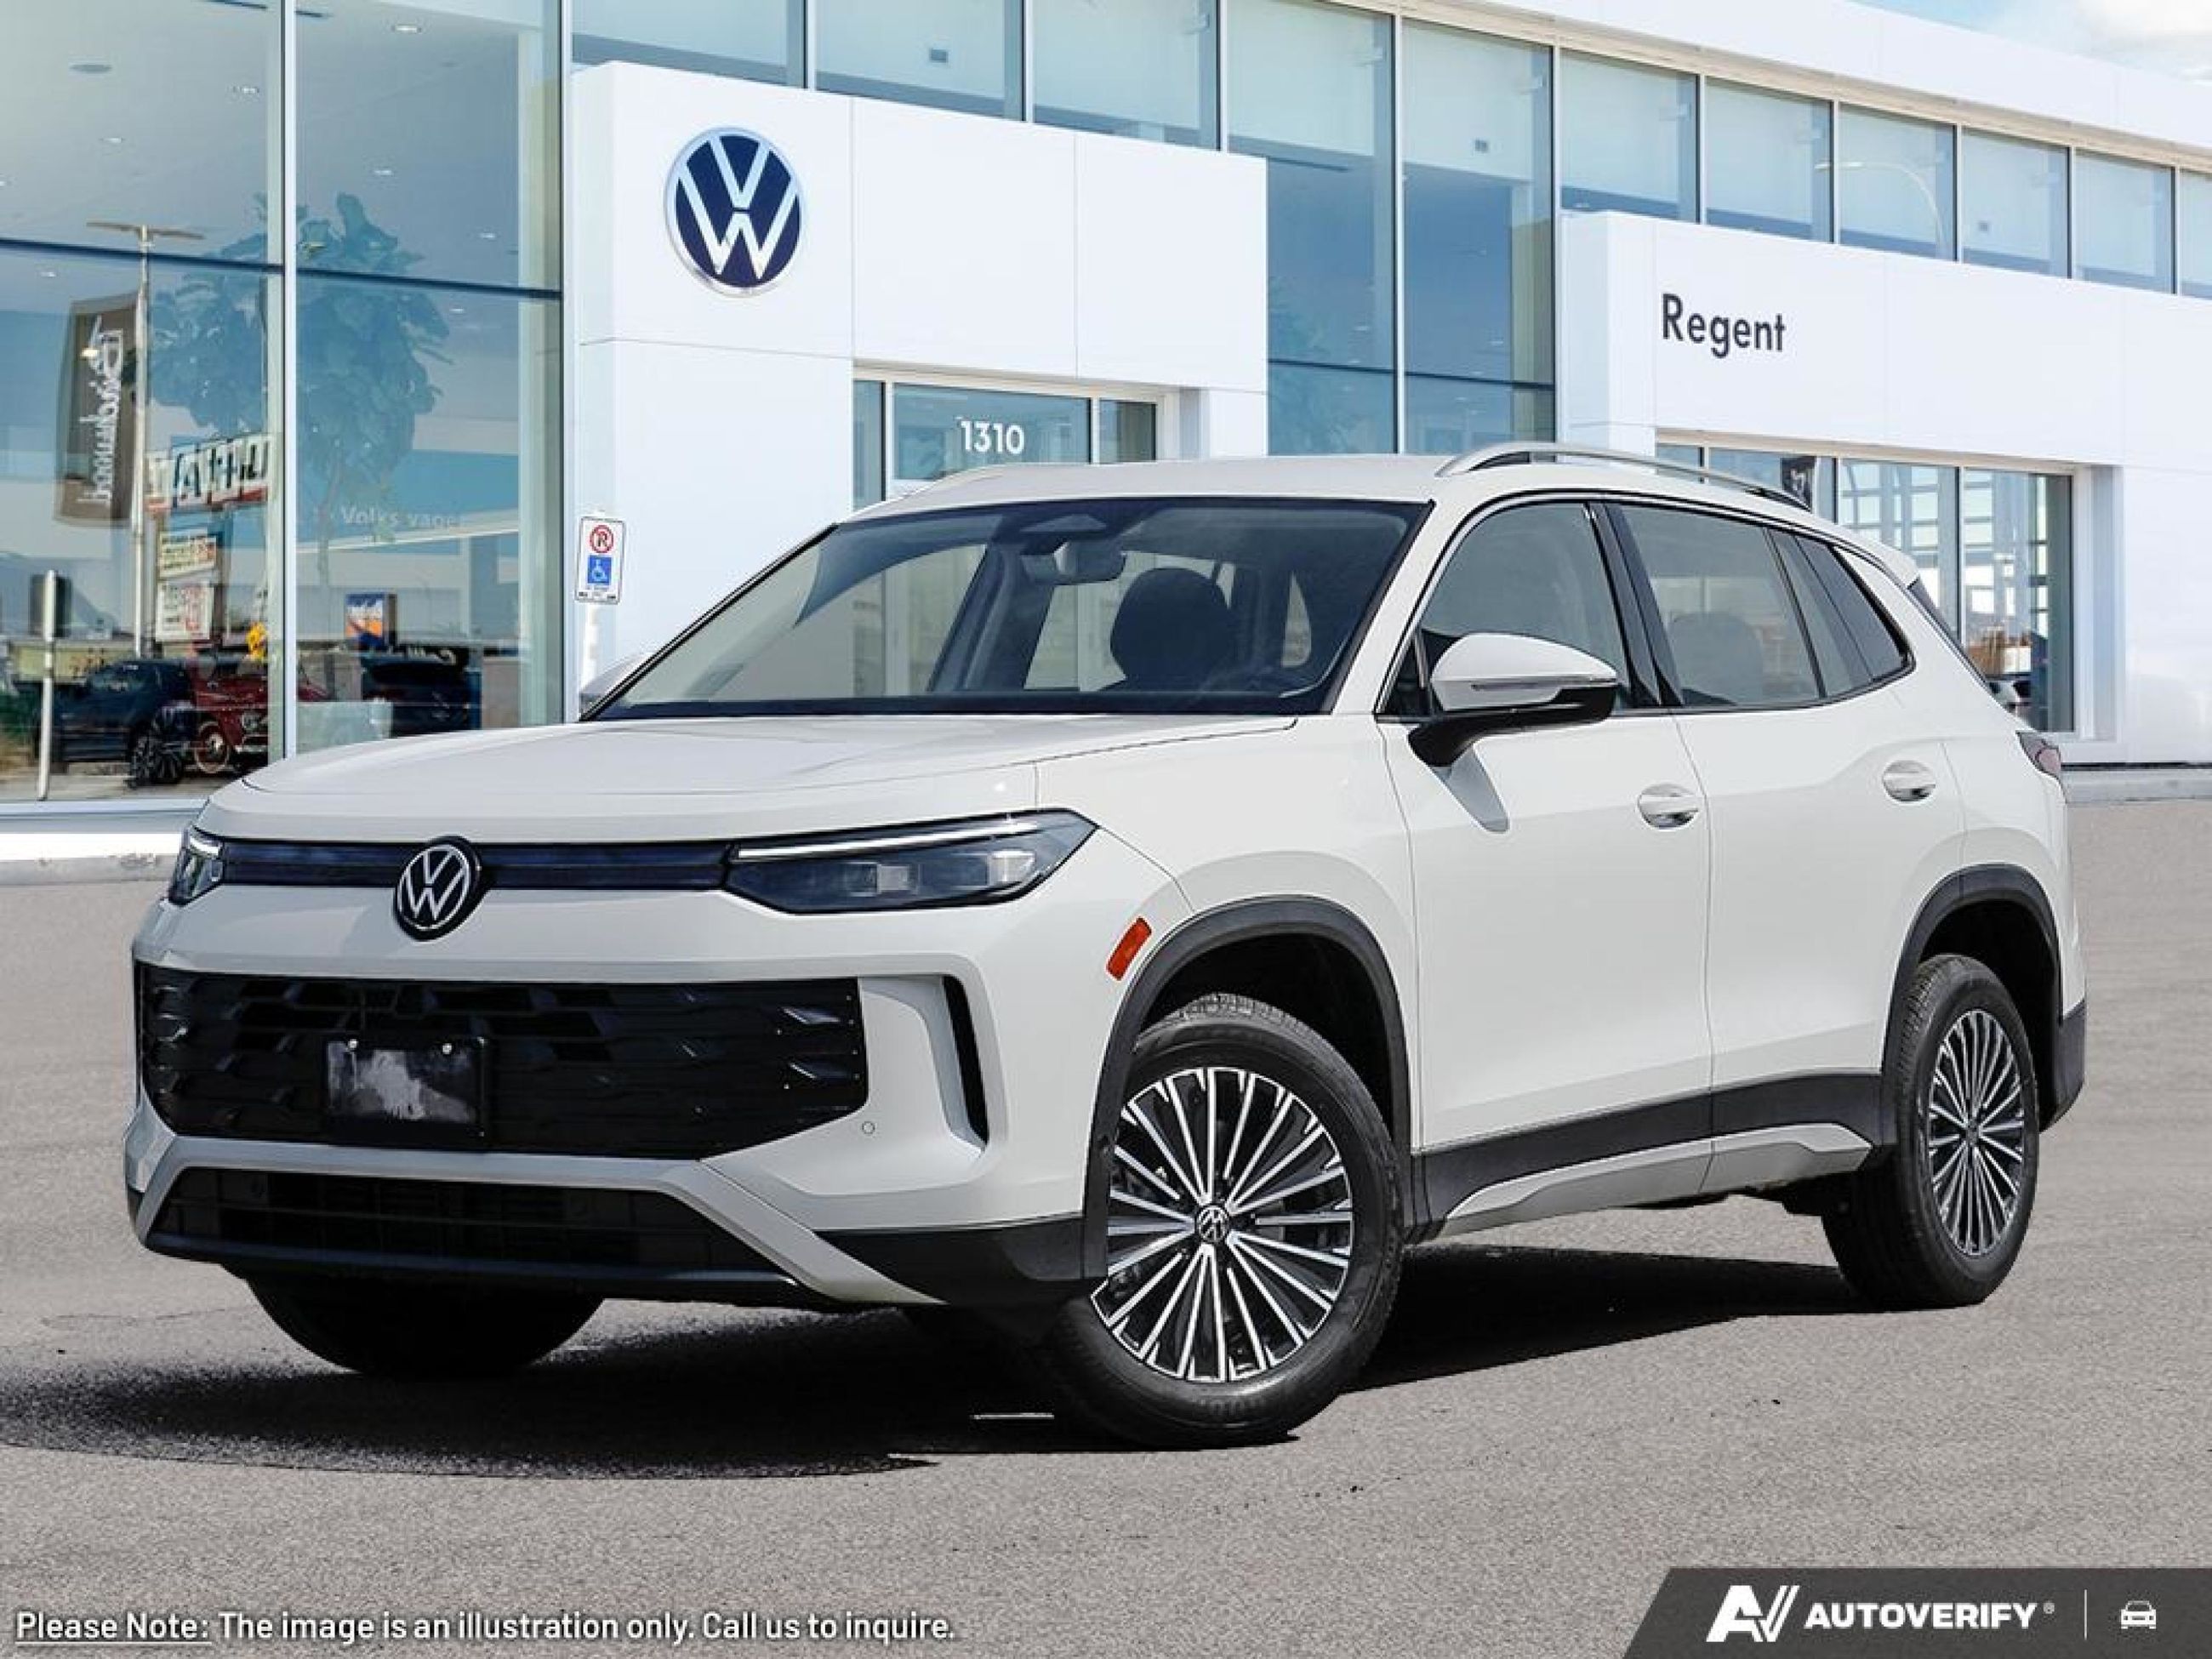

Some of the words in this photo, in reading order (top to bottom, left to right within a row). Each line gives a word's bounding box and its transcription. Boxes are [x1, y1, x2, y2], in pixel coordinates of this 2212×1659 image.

[668, 129, 804, 291] VW
[1662, 293, 1787, 359] Regent
[961, 419, 1025, 455] 1310
[398, 844, 470, 929] VW
